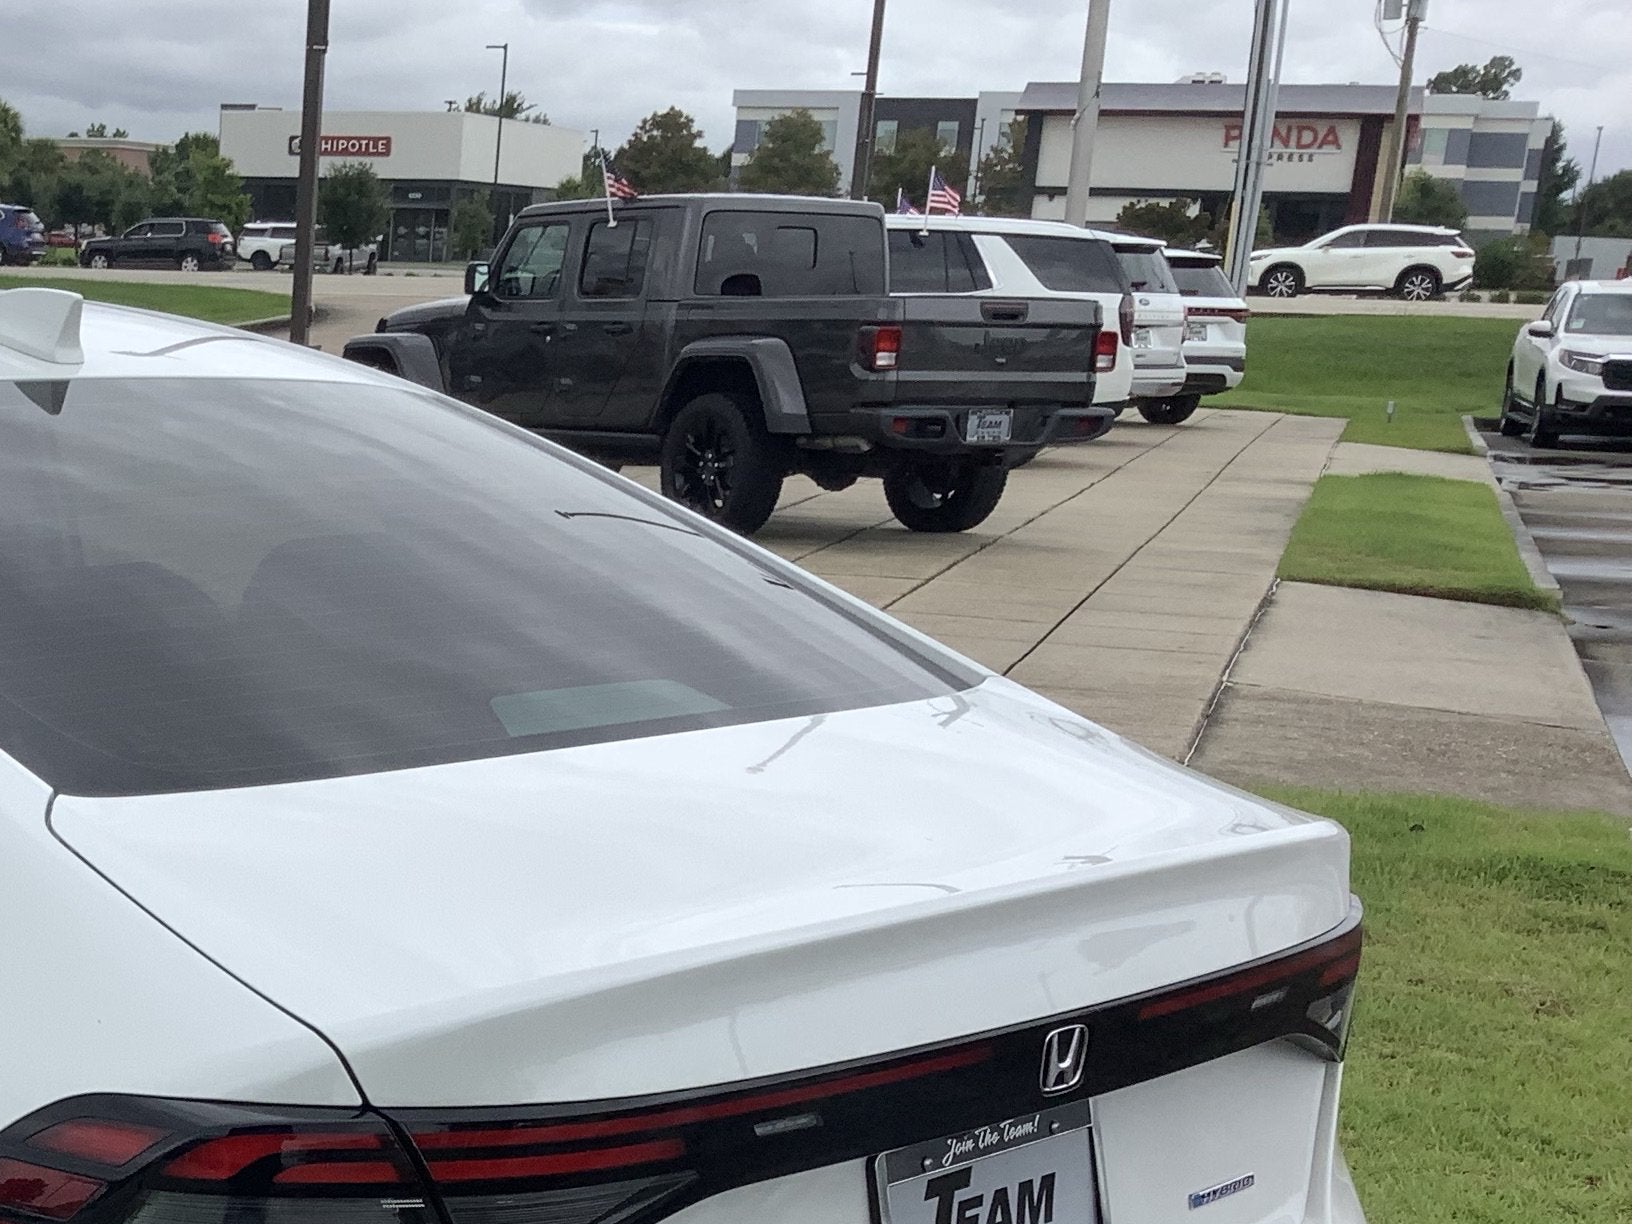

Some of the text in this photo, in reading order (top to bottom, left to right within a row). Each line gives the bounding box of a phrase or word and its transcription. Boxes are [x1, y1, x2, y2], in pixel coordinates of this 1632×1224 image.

[318, 139, 388, 153] HIPOTLE
[1224, 125, 1342, 150] PNDA
[942, 1114, 1041, 1166] Join The Team!
